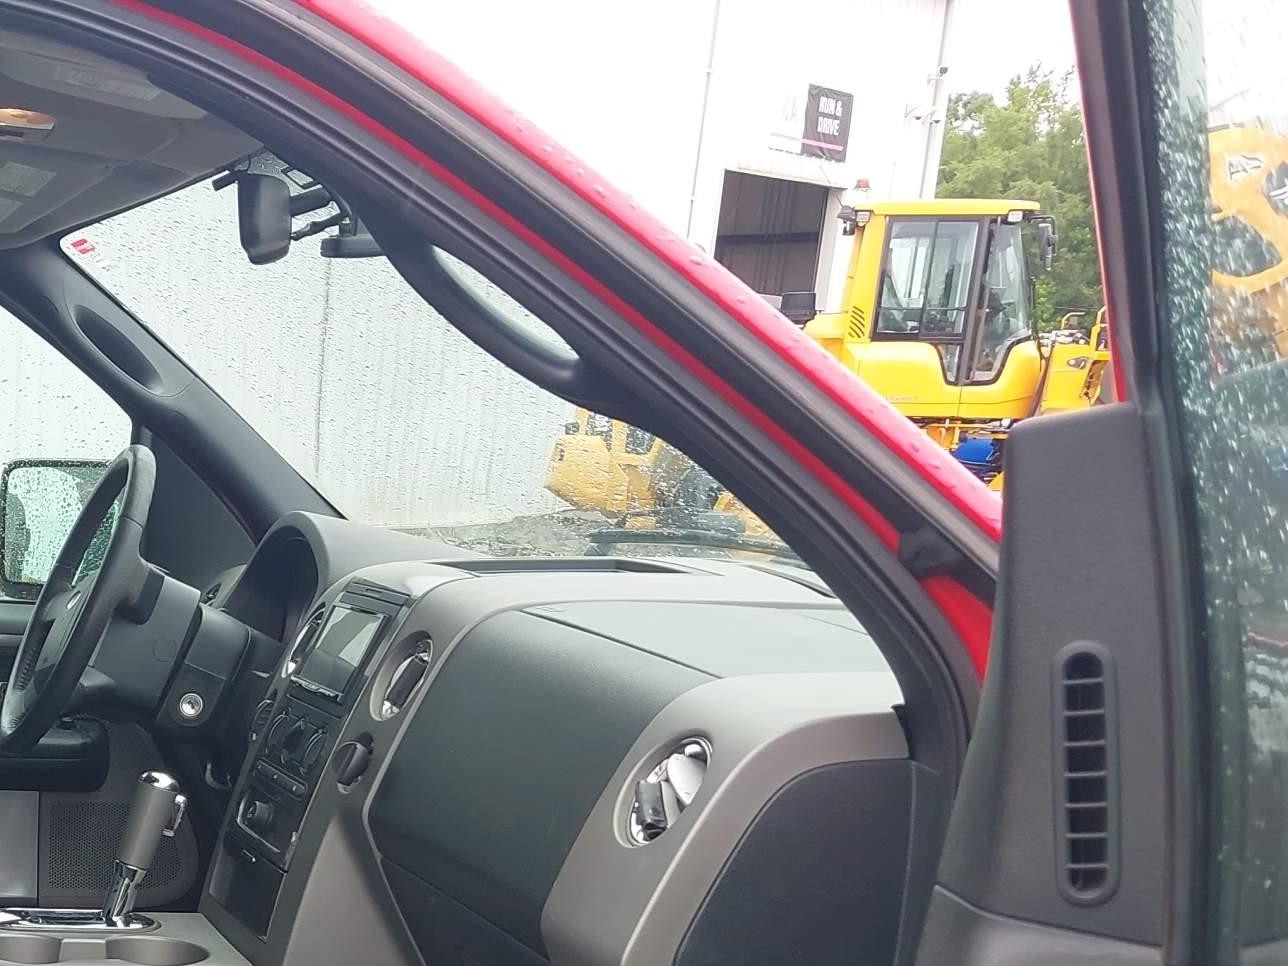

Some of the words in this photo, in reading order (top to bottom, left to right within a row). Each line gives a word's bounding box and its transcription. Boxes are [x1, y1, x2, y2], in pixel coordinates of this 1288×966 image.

[818, 95, 836, 115] RUN
[835, 99, 843, 117] &
[816, 116, 841, 136] DRIVE
